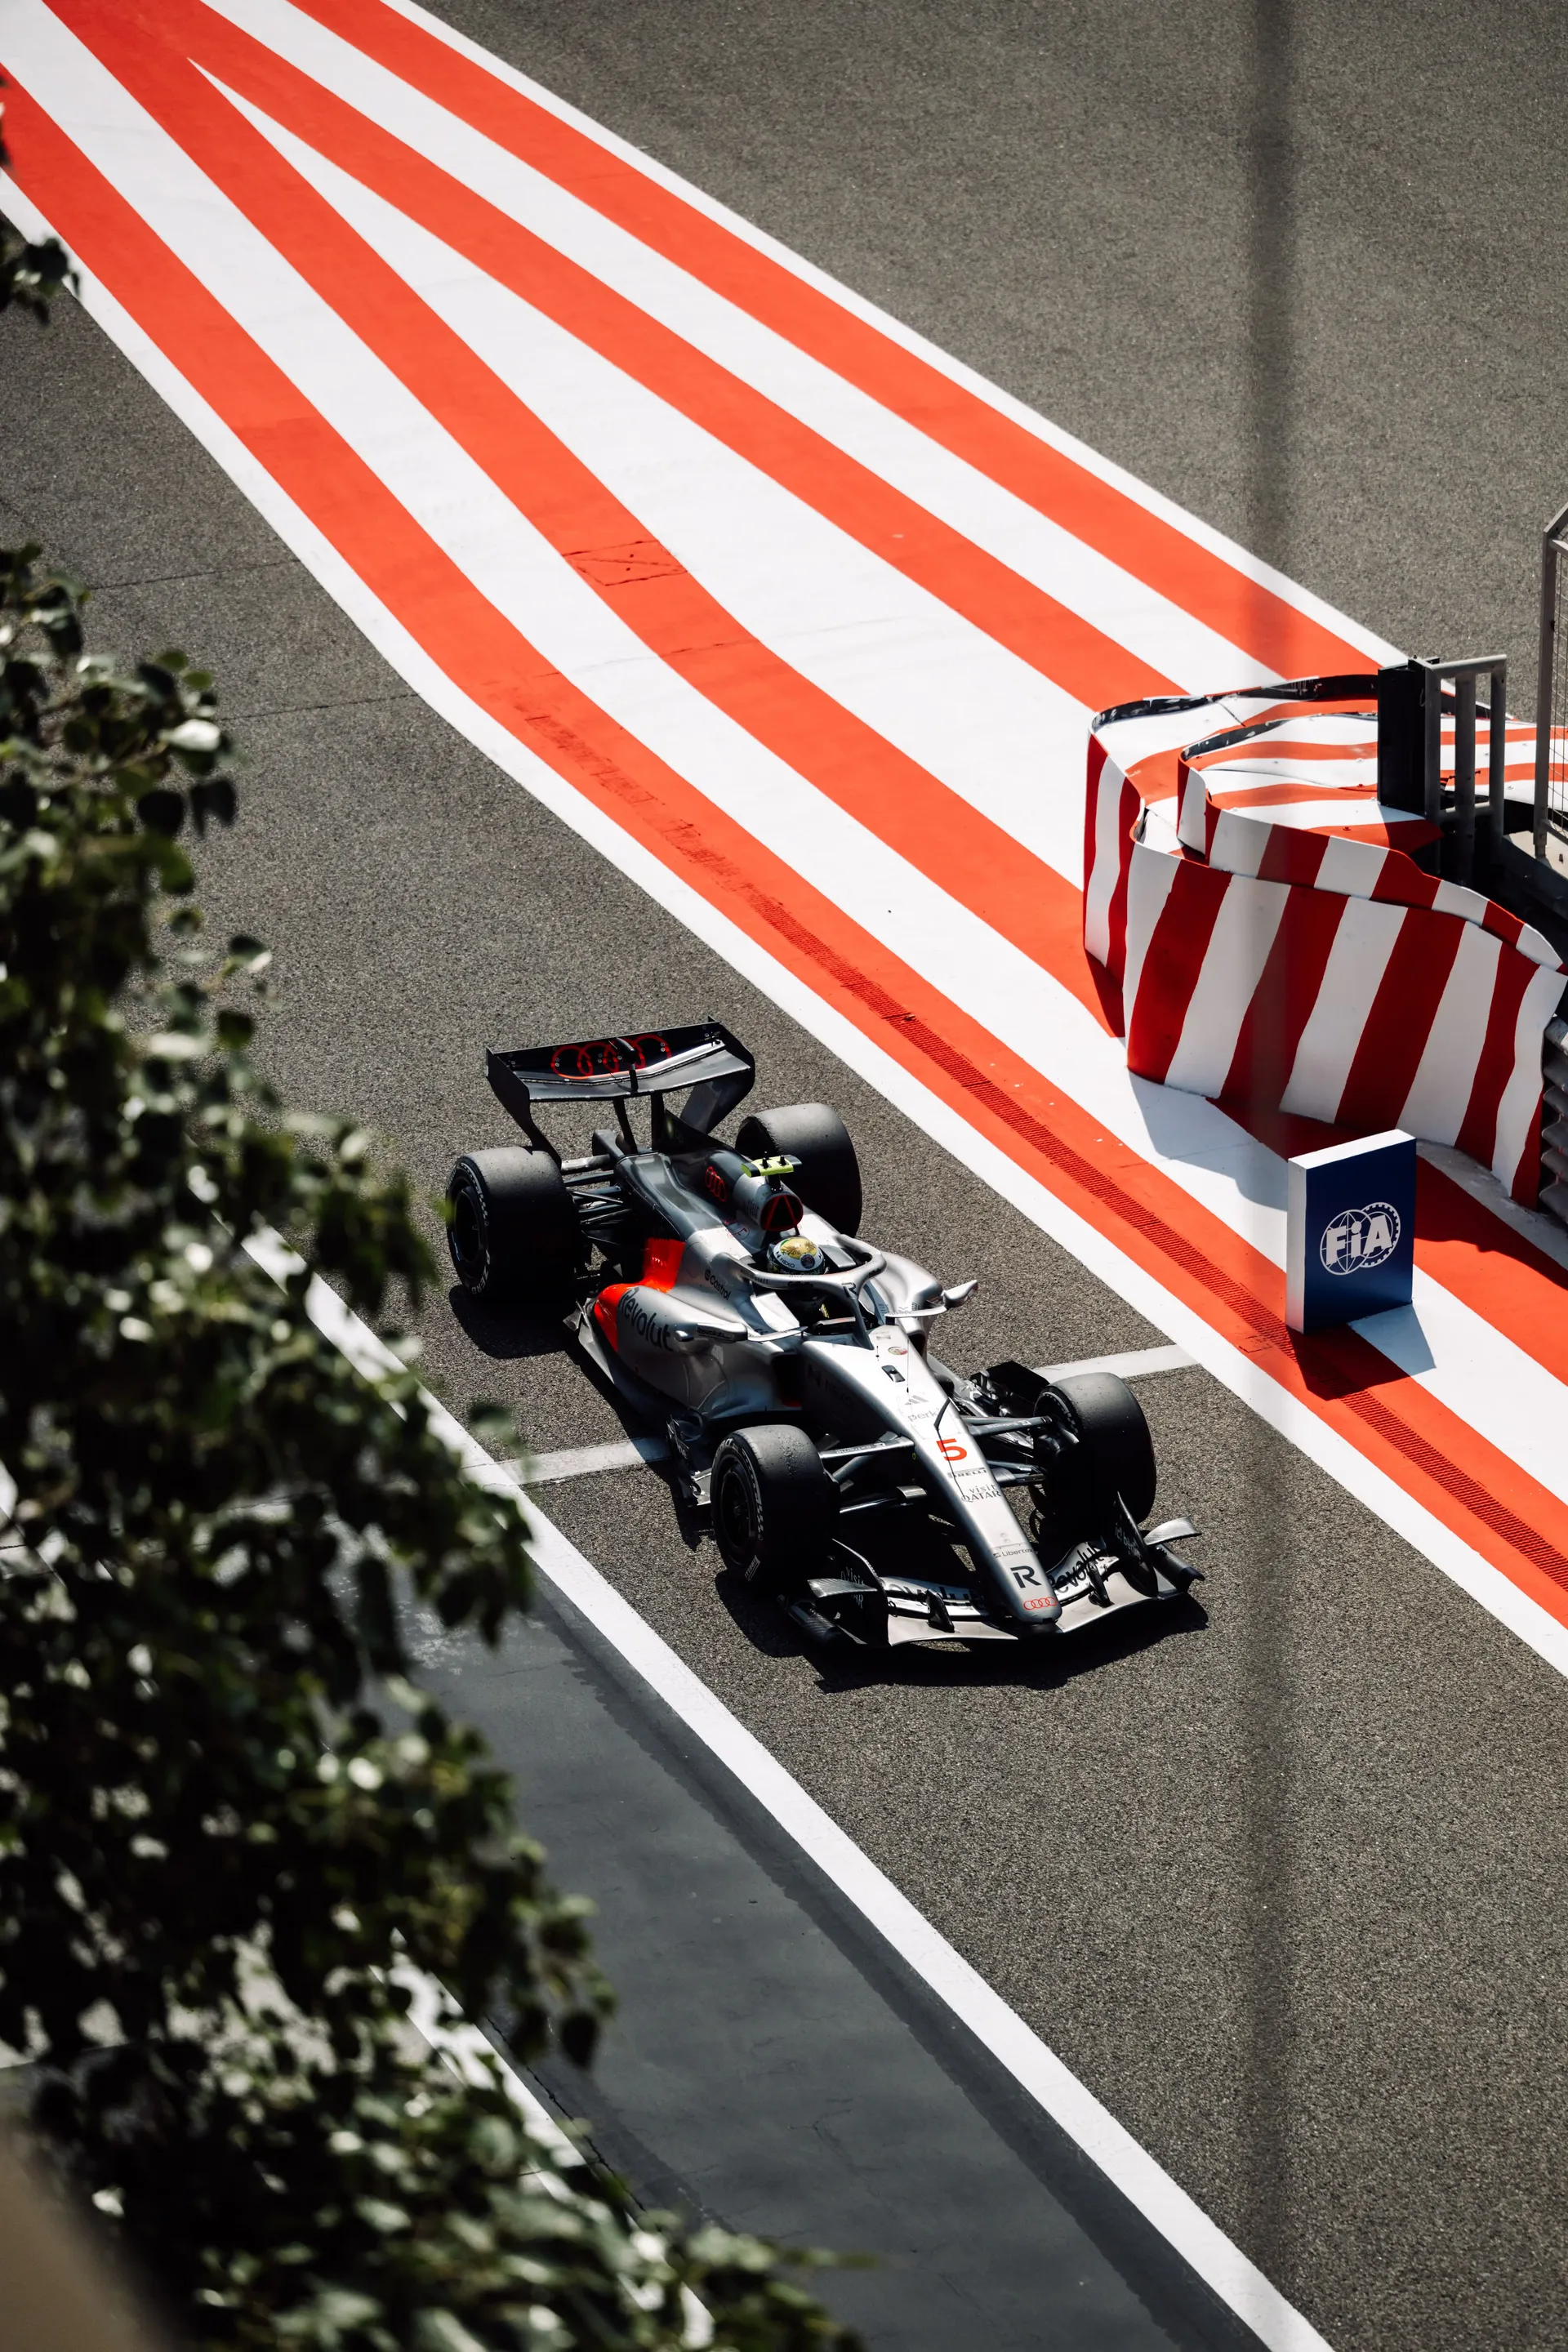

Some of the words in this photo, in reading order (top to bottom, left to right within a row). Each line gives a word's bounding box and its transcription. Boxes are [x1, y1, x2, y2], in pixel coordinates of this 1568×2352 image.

[779, 1257, 795, 1268] NEXO
[471, 1264, 489, 1295] ZERO
[710, 1275, 732, 1301] Castrol
[617, 1287, 675, 1352] Revolut
[907, 1410, 937, 1422] perk
[936, 1438, 968, 1461] 5
[947, 1467, 987, 1478] PIRELLI
[969, 1484, 998, 1494] visit
[961, 1490, 1001, 1503] QATAR
[1001, 1548, 1034, 1557] Libertex
